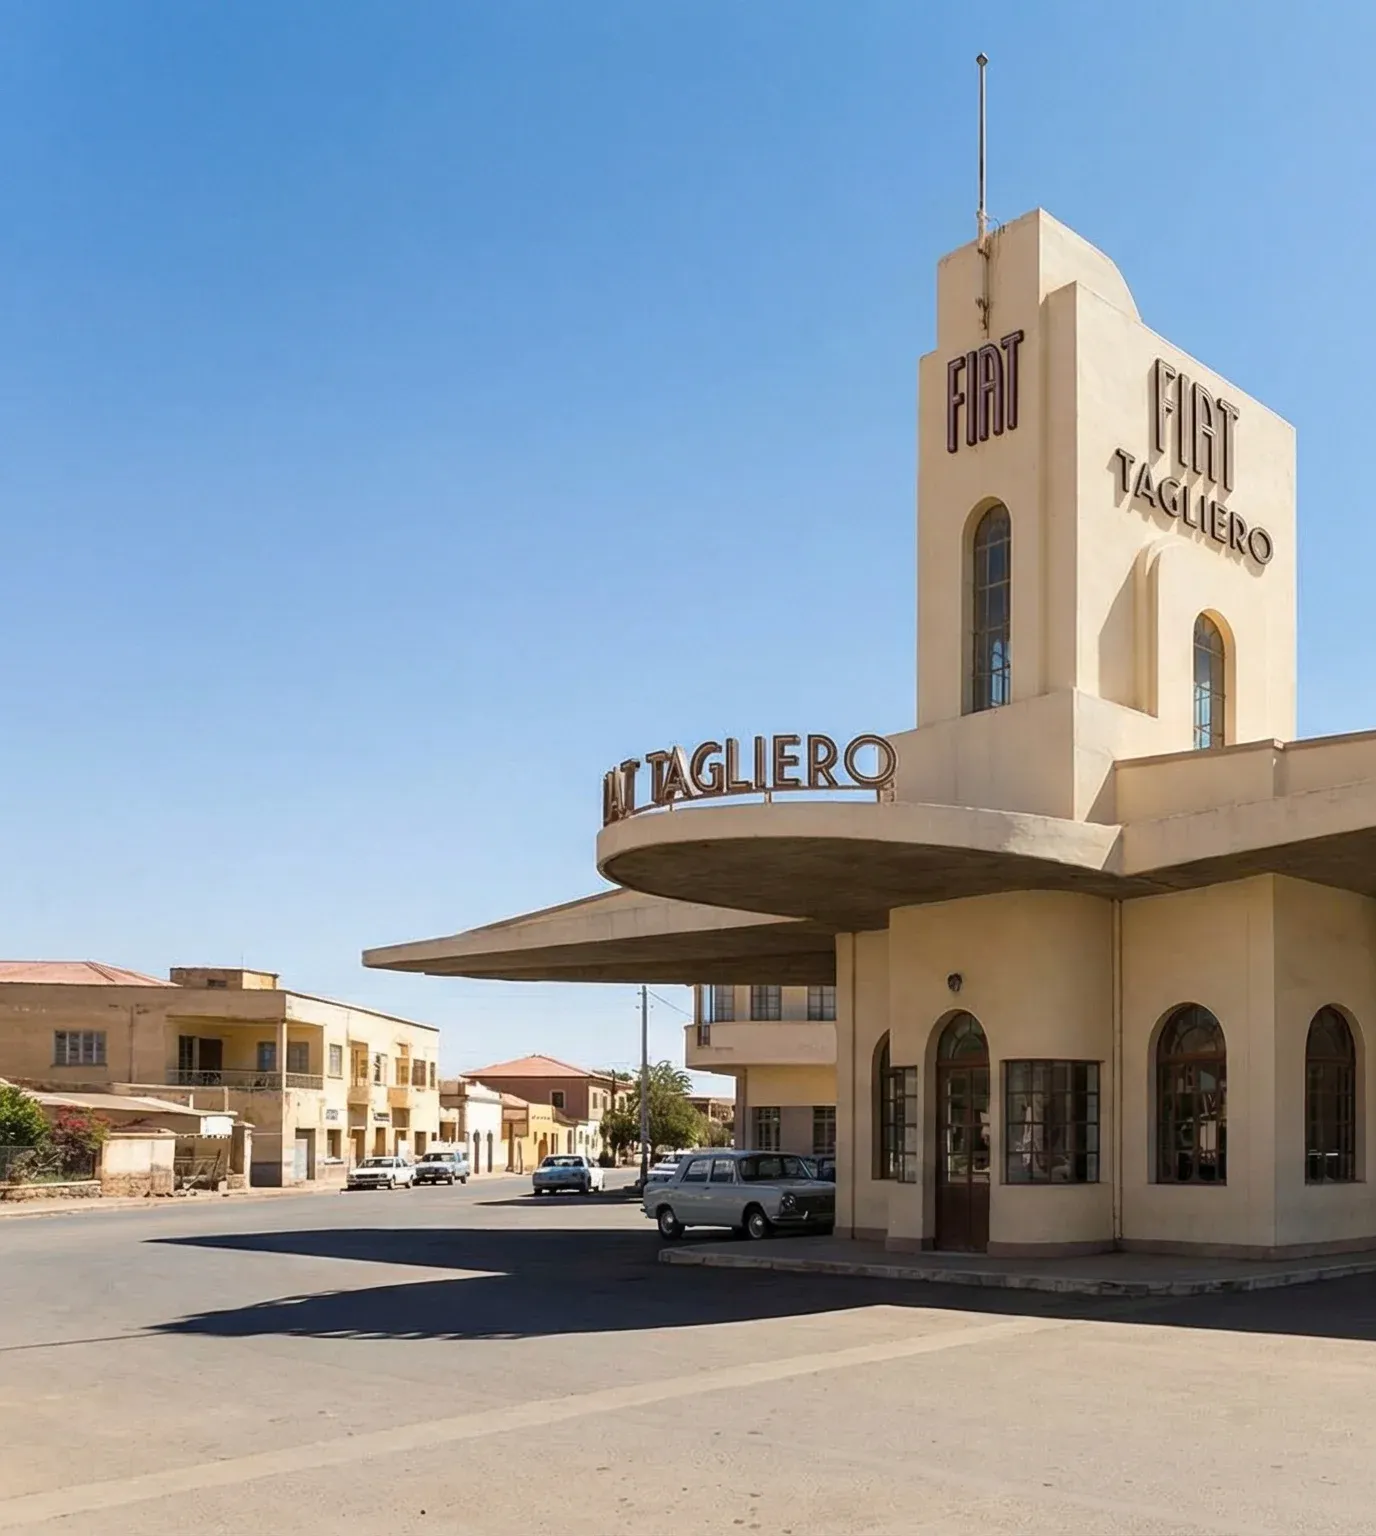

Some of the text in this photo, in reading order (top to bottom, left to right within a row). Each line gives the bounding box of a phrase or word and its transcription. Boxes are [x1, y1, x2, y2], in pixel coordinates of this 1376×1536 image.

[946, 329, 1025, 454] FIAT
[1154, 357, 1240, 492] FIAT
[1115, 447, 1275, 566] TAGLIERO
[646, 733, 898, 805] TAGLIERO
